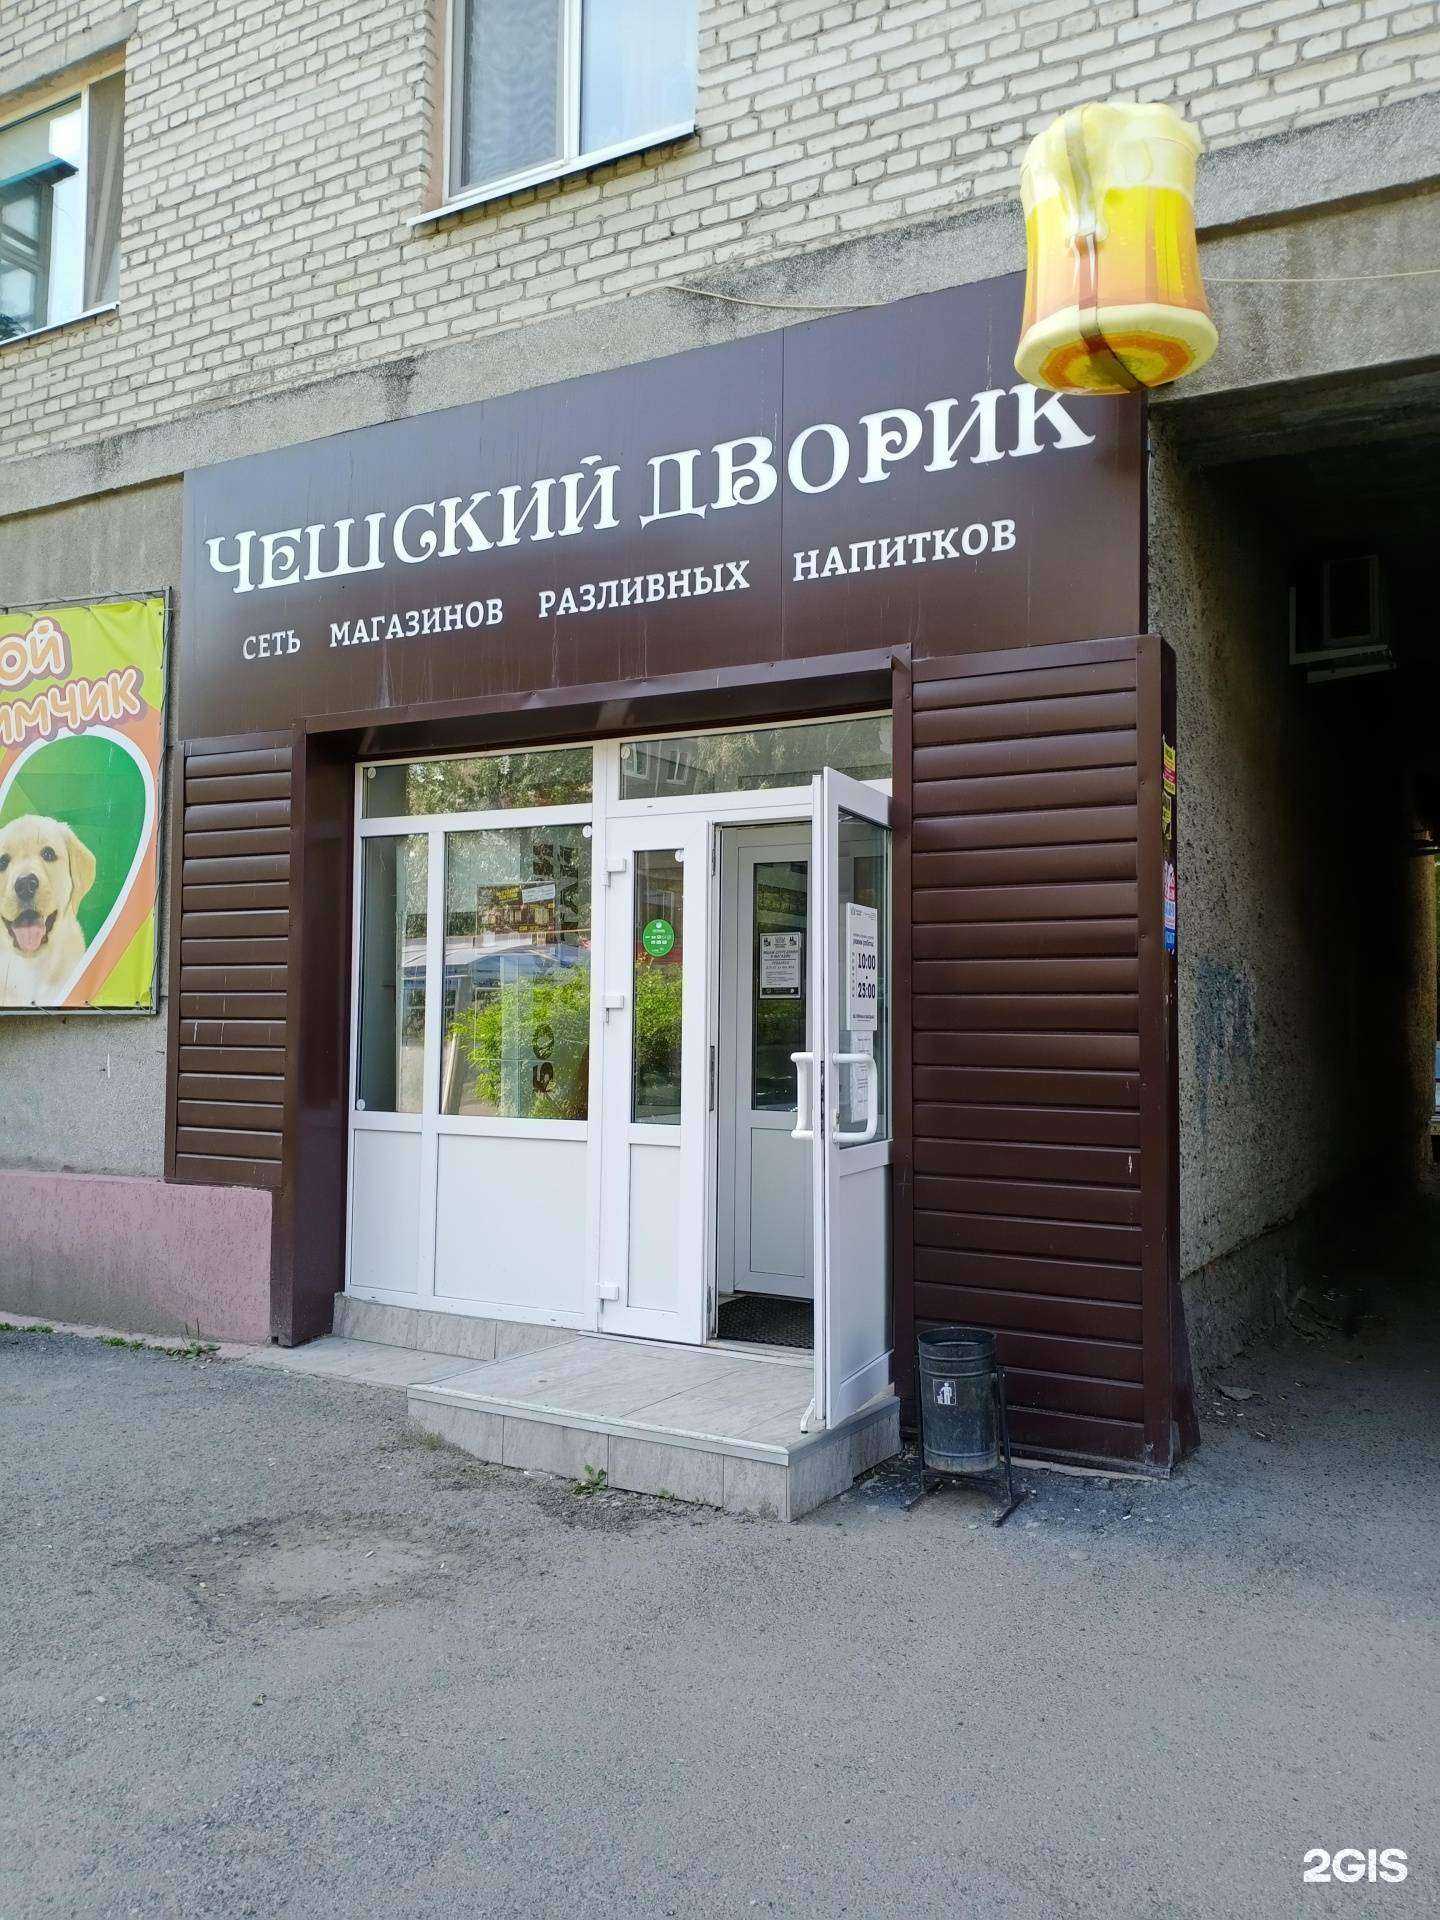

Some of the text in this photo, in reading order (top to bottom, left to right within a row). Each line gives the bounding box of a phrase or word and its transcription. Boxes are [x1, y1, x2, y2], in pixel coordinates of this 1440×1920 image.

[205, 382, 1097, 594] ЧЕШСКИЙ ДВОРИК
[242, 519, 1018, 661] СЕТЬ МАГАЗИНОВ РАЗЛИВНЫХ НАПИТКОВ
[857, 952, 876, 970] 10:00
[857, 982, 876, 999] 23:00
